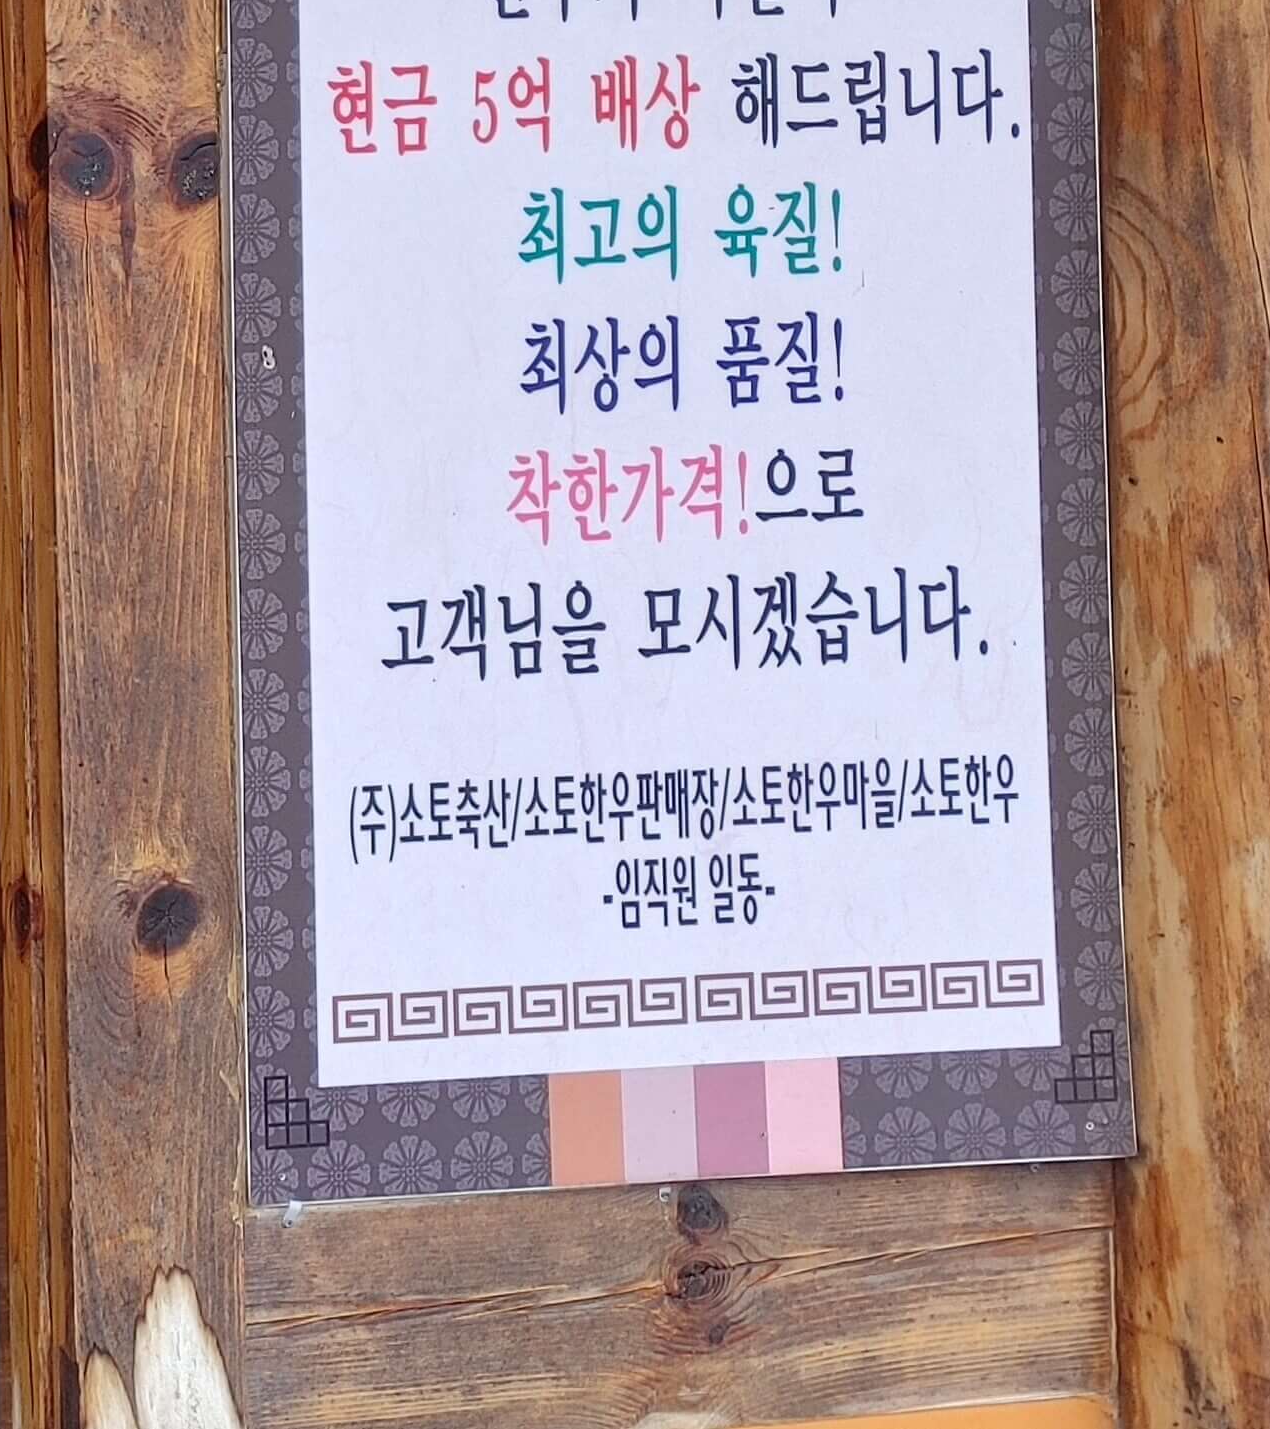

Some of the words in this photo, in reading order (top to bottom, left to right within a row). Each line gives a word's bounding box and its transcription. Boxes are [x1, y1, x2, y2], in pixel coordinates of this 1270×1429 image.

[327, 60, 437, 156] 현금
[473, 57, 552, 152] 5억
[591, 53, 701, 151] 배상
[731, 48, 1021, 149] 해드립니다.
[518, 184, 678, 283] 최고의
[713, 181, 842, 278] 육질!
[520, 314, 680, 414] 최상의
[716, 311, 844, 408] 품질!
[507, 444, 864, 546] 착한가격!으로
[381, 580, 607, 682] 고객님을
[638, 565, 988, 670] 모시겠습니다.
